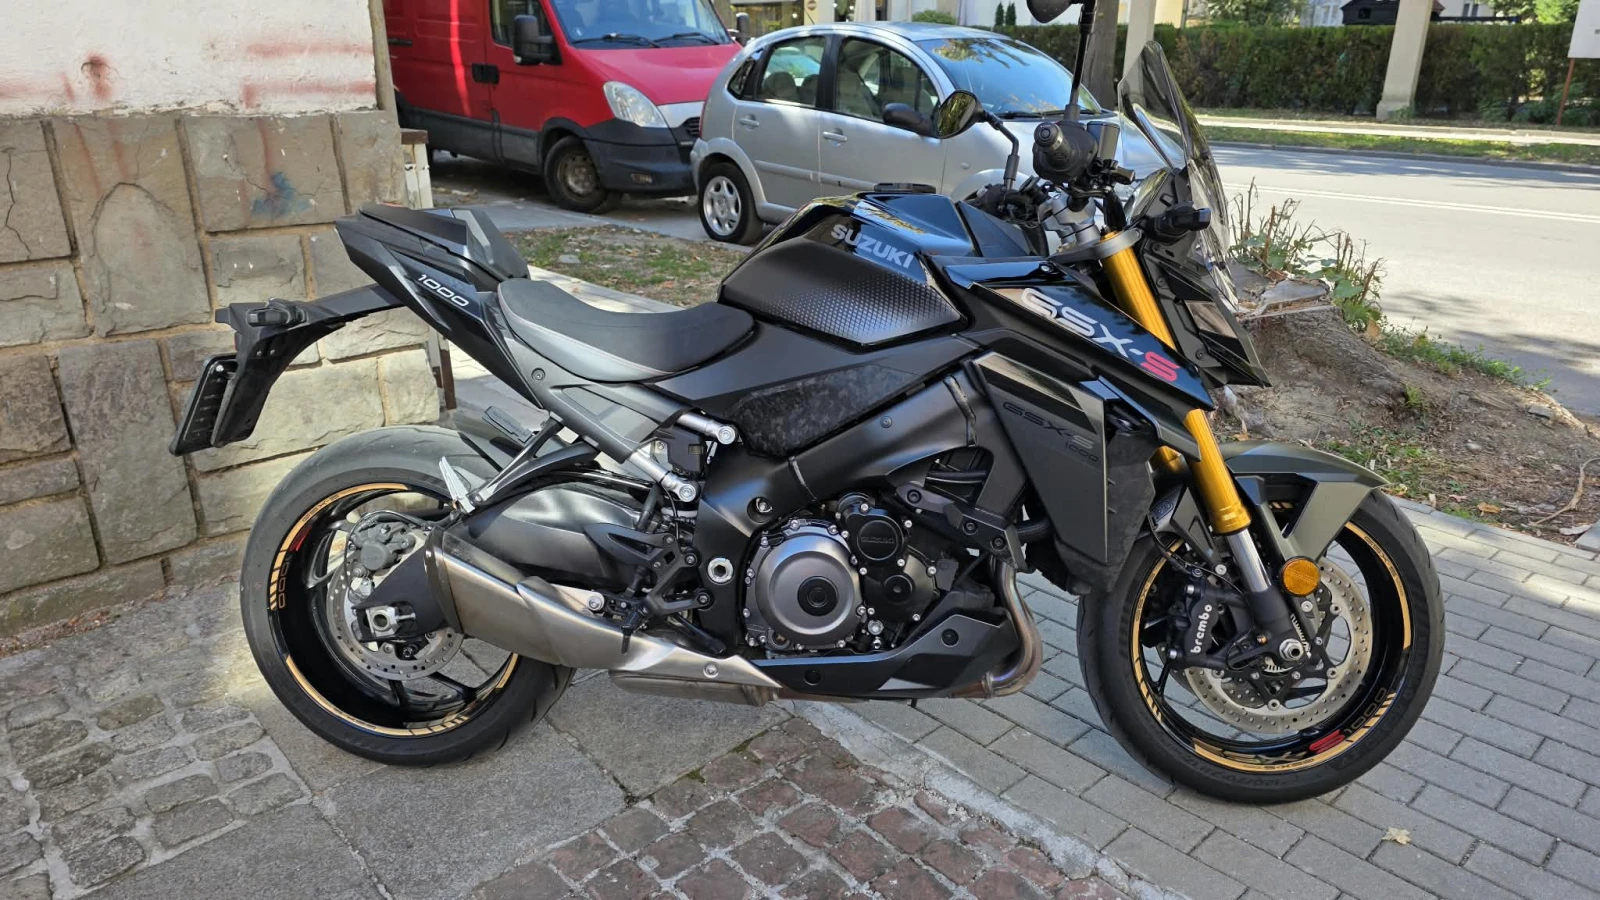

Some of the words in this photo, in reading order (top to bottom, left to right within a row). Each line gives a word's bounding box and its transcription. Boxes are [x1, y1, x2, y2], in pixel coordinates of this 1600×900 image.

[831, 223, 914, 269] SUZUKI
[418, 274, 470, 307] 1000
[1021, 287, 1180, 382] GSX-S
[1003, 401, 1095, 449] GSX-S
[1065, 442, 1099, 462] 1000
[1190, 604, 1213, 654] brembo
